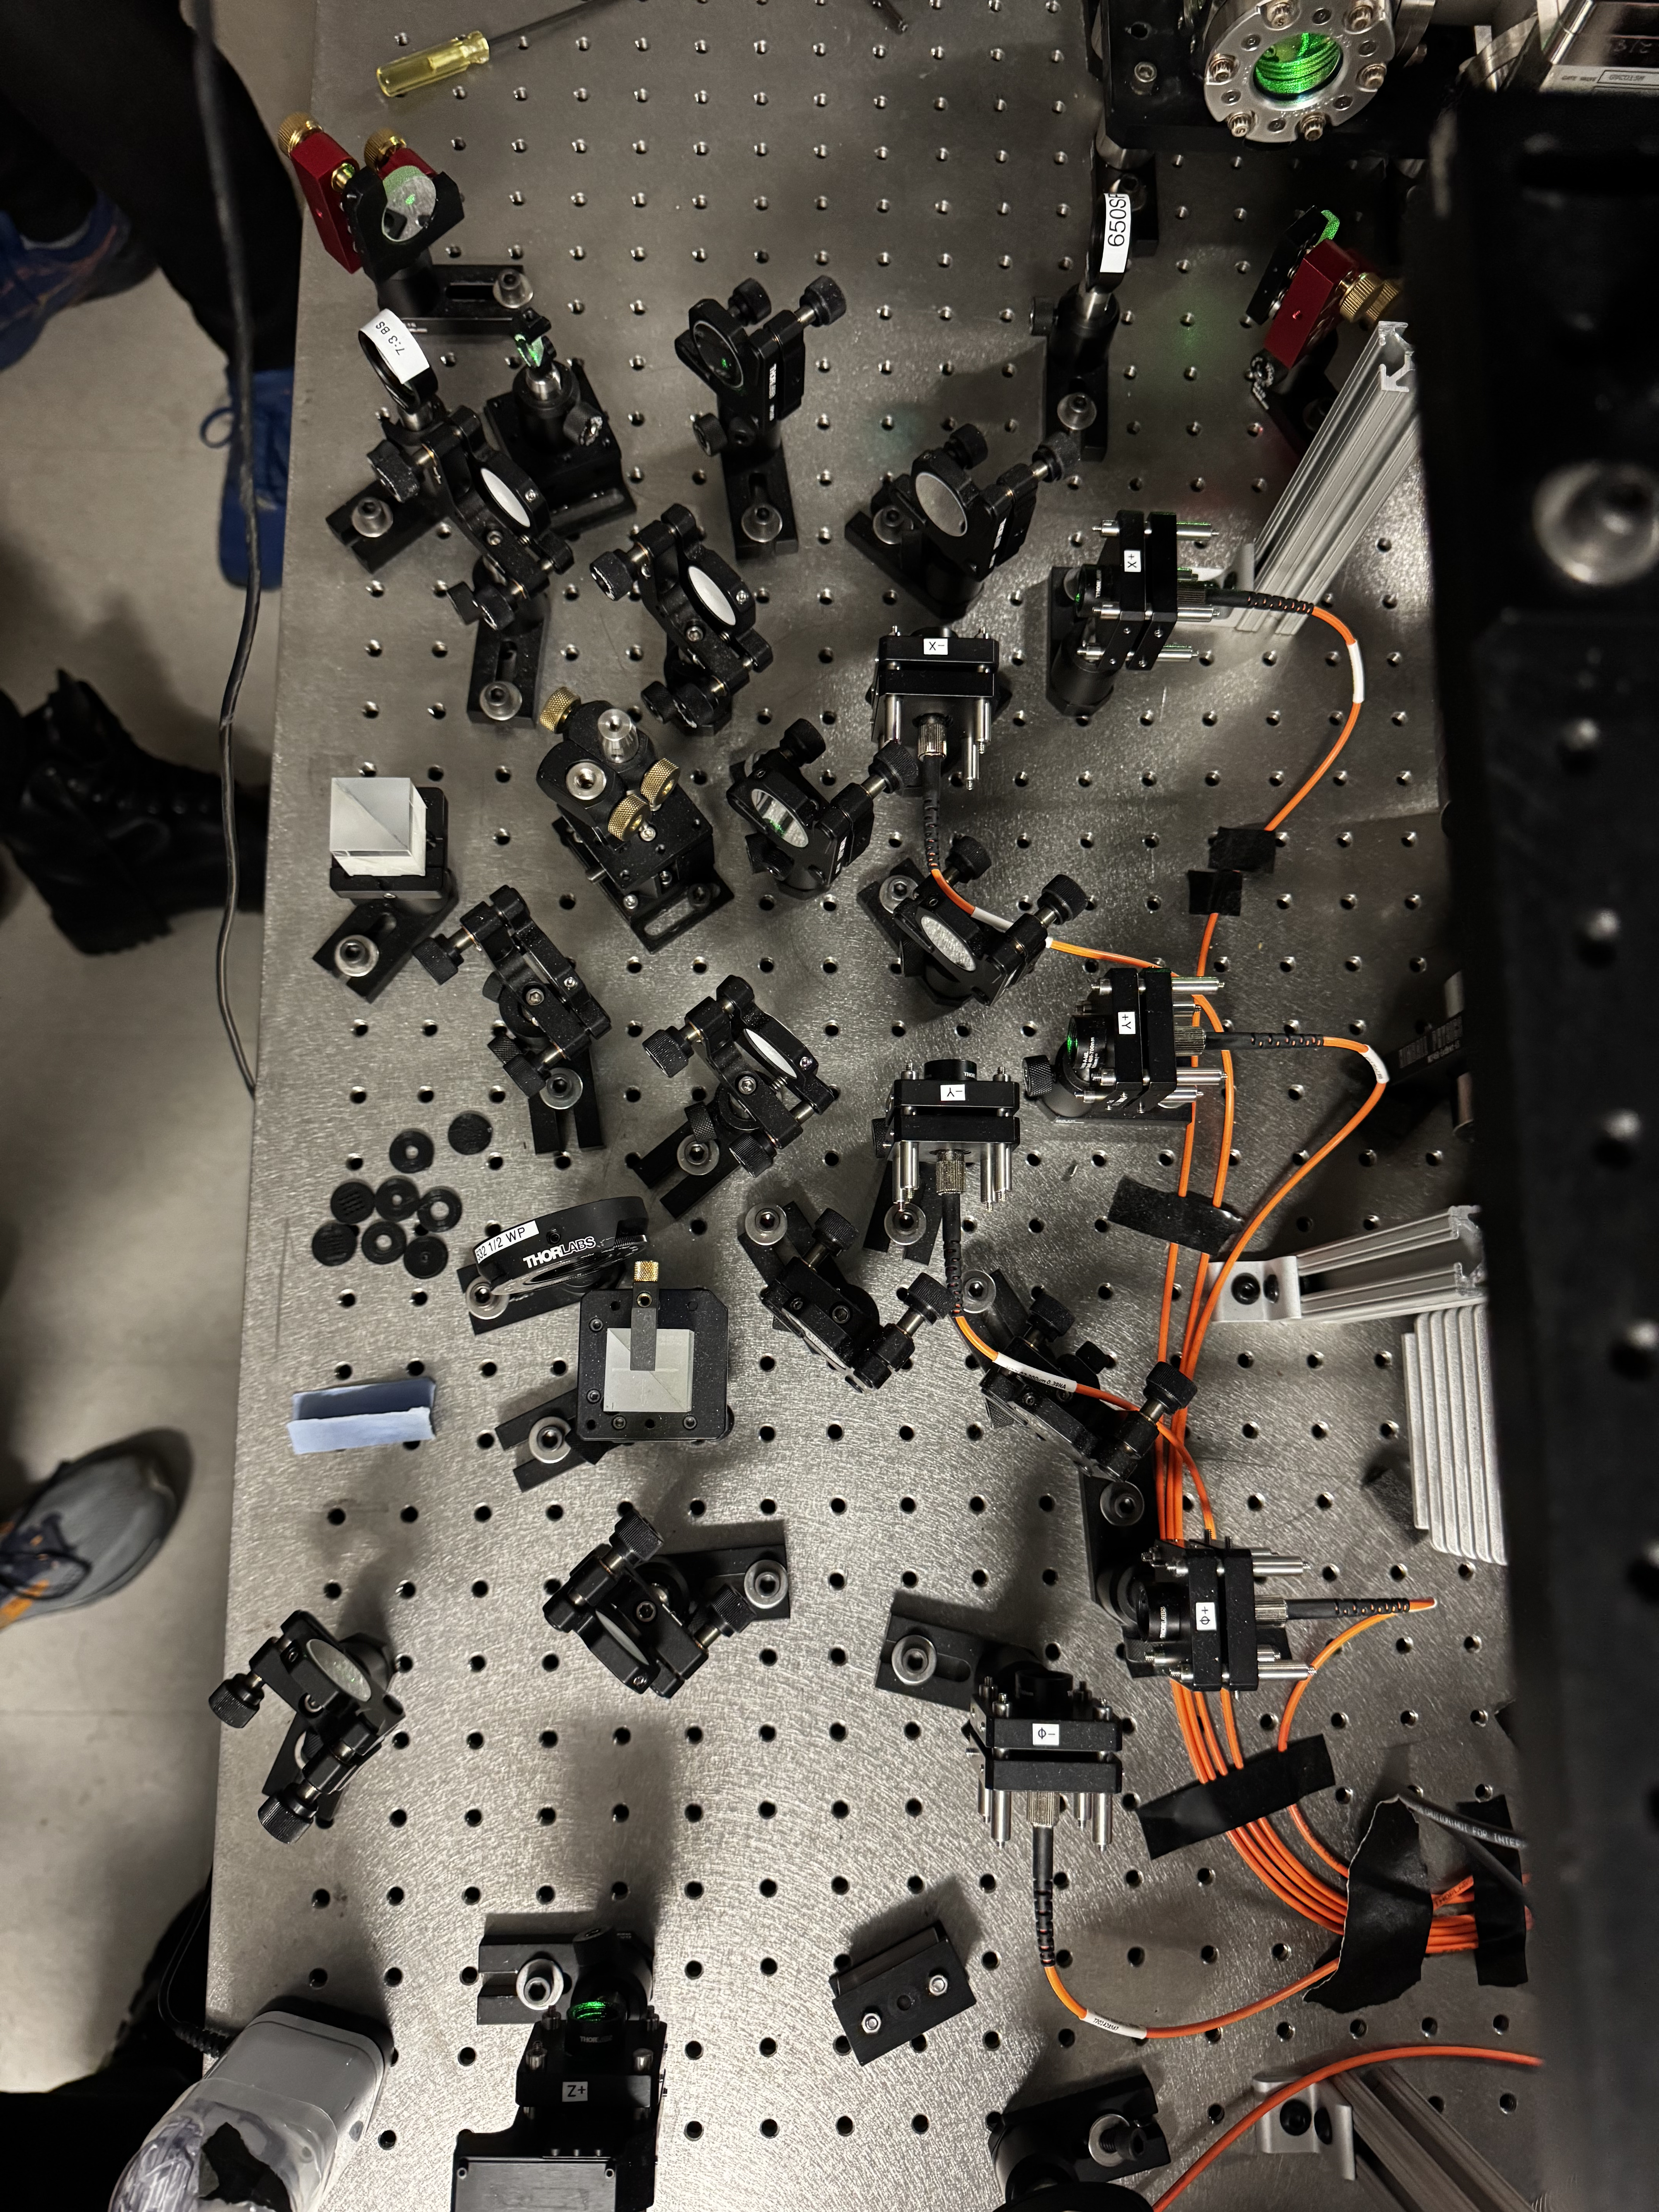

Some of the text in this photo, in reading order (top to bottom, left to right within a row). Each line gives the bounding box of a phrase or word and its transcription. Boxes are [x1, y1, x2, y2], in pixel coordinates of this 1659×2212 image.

[376, 321, 405, 356] 7:3 BS
[476, 1227, 526, 1261] 532 1/2 WP
[522, 1236, 596, 1268] THORLABS
